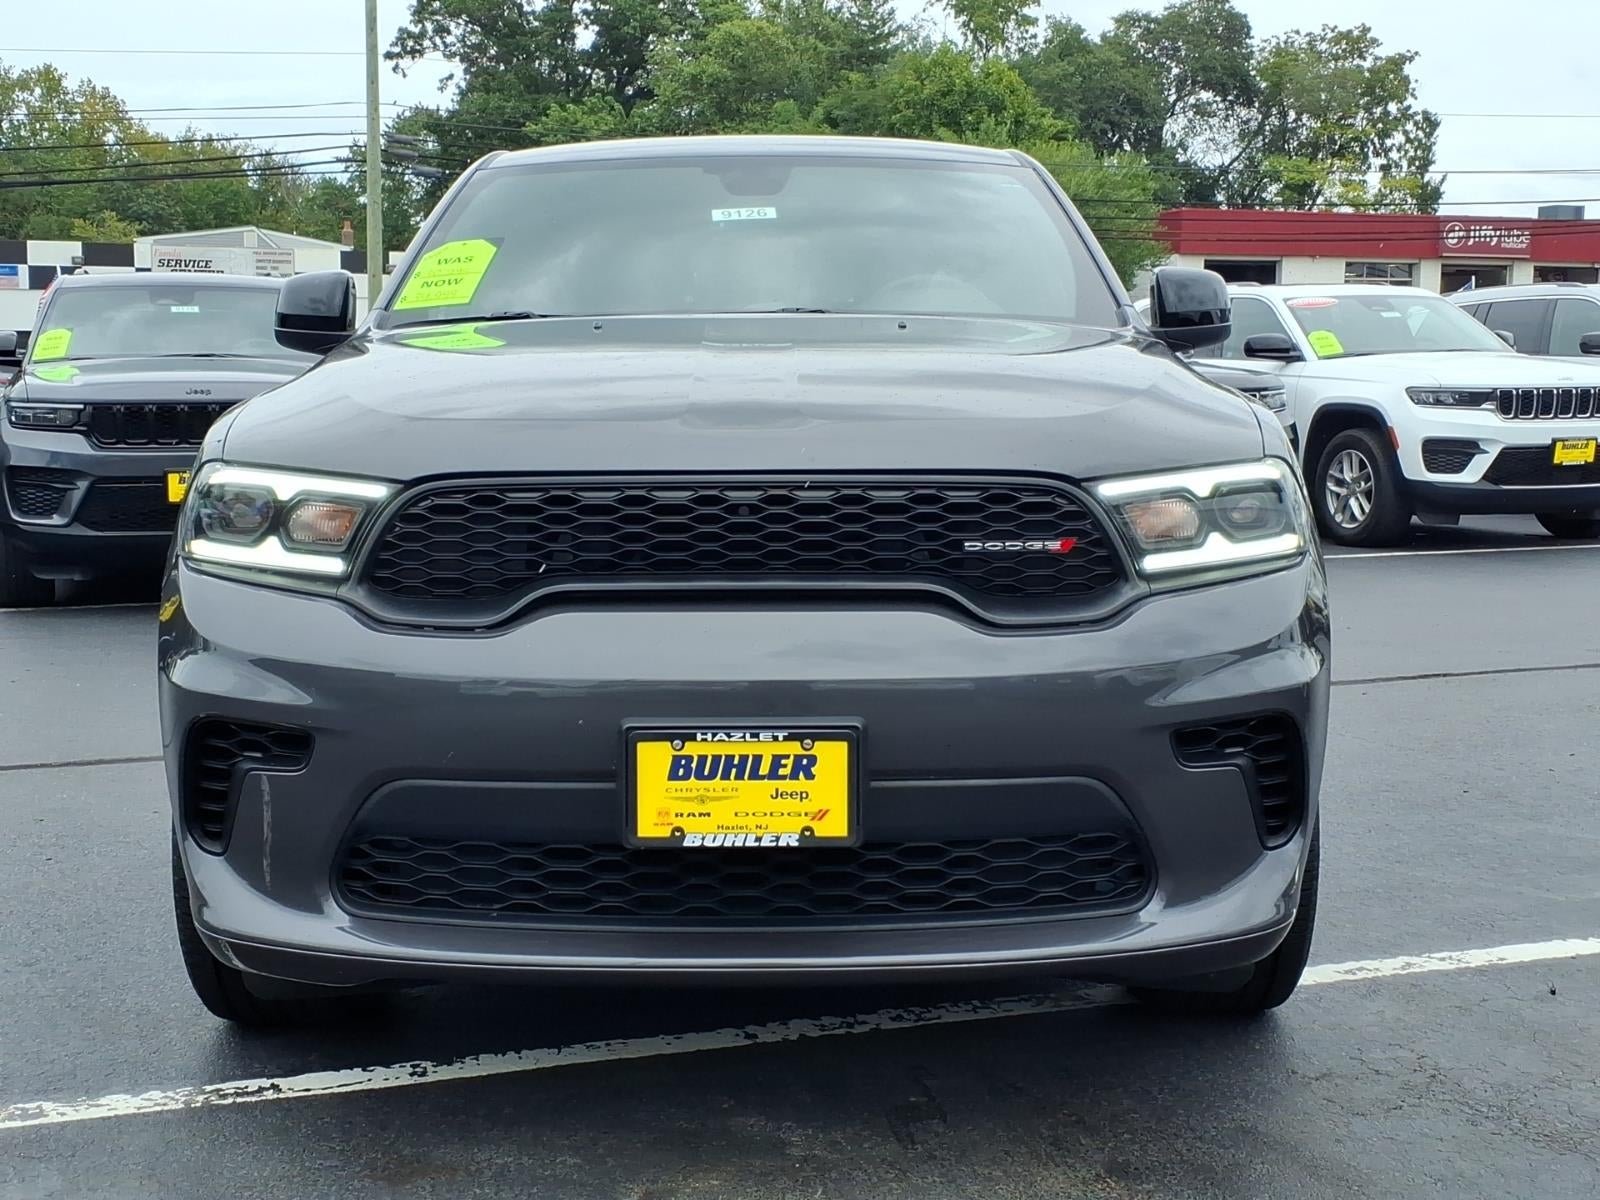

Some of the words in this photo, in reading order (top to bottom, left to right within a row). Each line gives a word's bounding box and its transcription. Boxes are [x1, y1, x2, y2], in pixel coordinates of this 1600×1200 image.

[721, 209, 767, 218] 9126
[1467, 225, 1501, 246] jiffy
[1501, 226, 1531, 243] lube
[157, 258, 213, 269] SERVICE
[437, 255, 475, 265] WAS
[421, 278, 464, 289] NOW
[964, 541, 1062, 551] DODGE
[696, 732, 789, 742] HAZLET
[667, 754, 819, 782] BUHLER
[770, 788, 810, 803] Jeep
[682, 832, 800, 847] BUHLER
